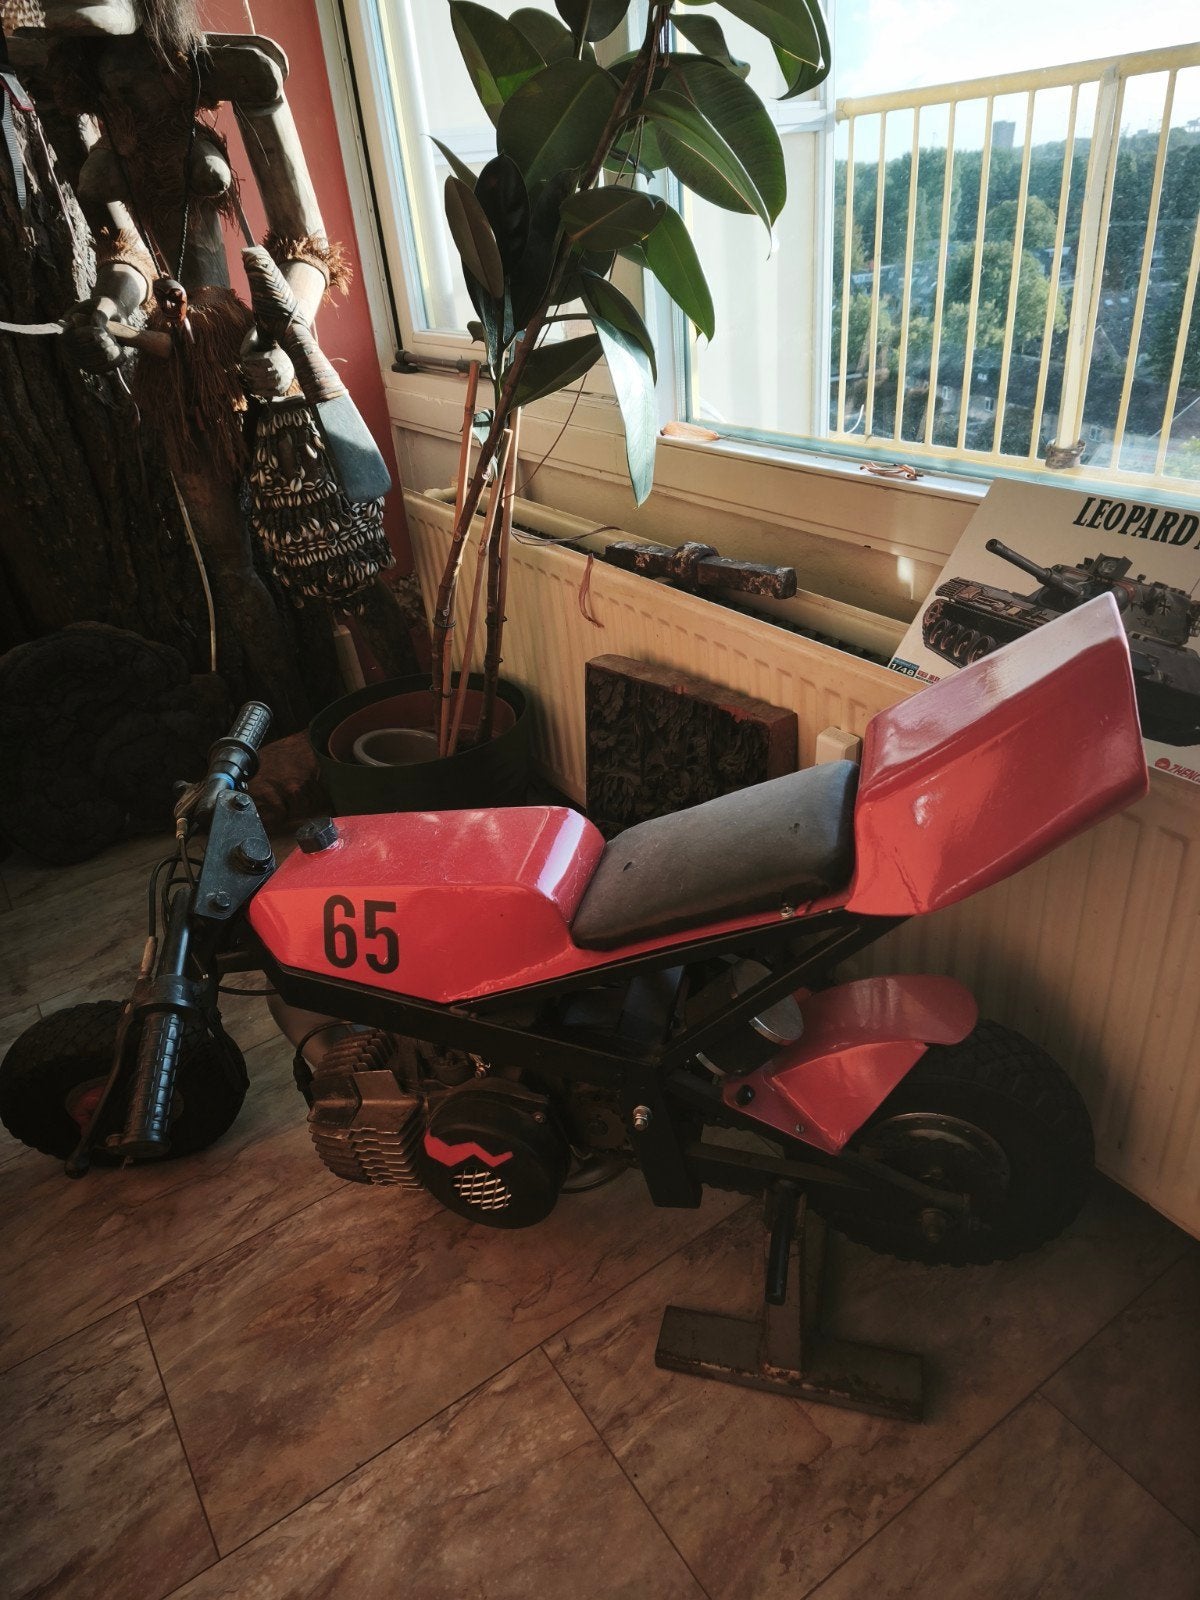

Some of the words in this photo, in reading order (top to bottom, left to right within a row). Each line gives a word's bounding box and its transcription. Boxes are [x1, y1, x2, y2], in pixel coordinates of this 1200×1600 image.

[1072, 497, 1199, 546] LEOPARD
[891, 663, 915, 676] 1/48
[323, 894, 400, 975] 65
